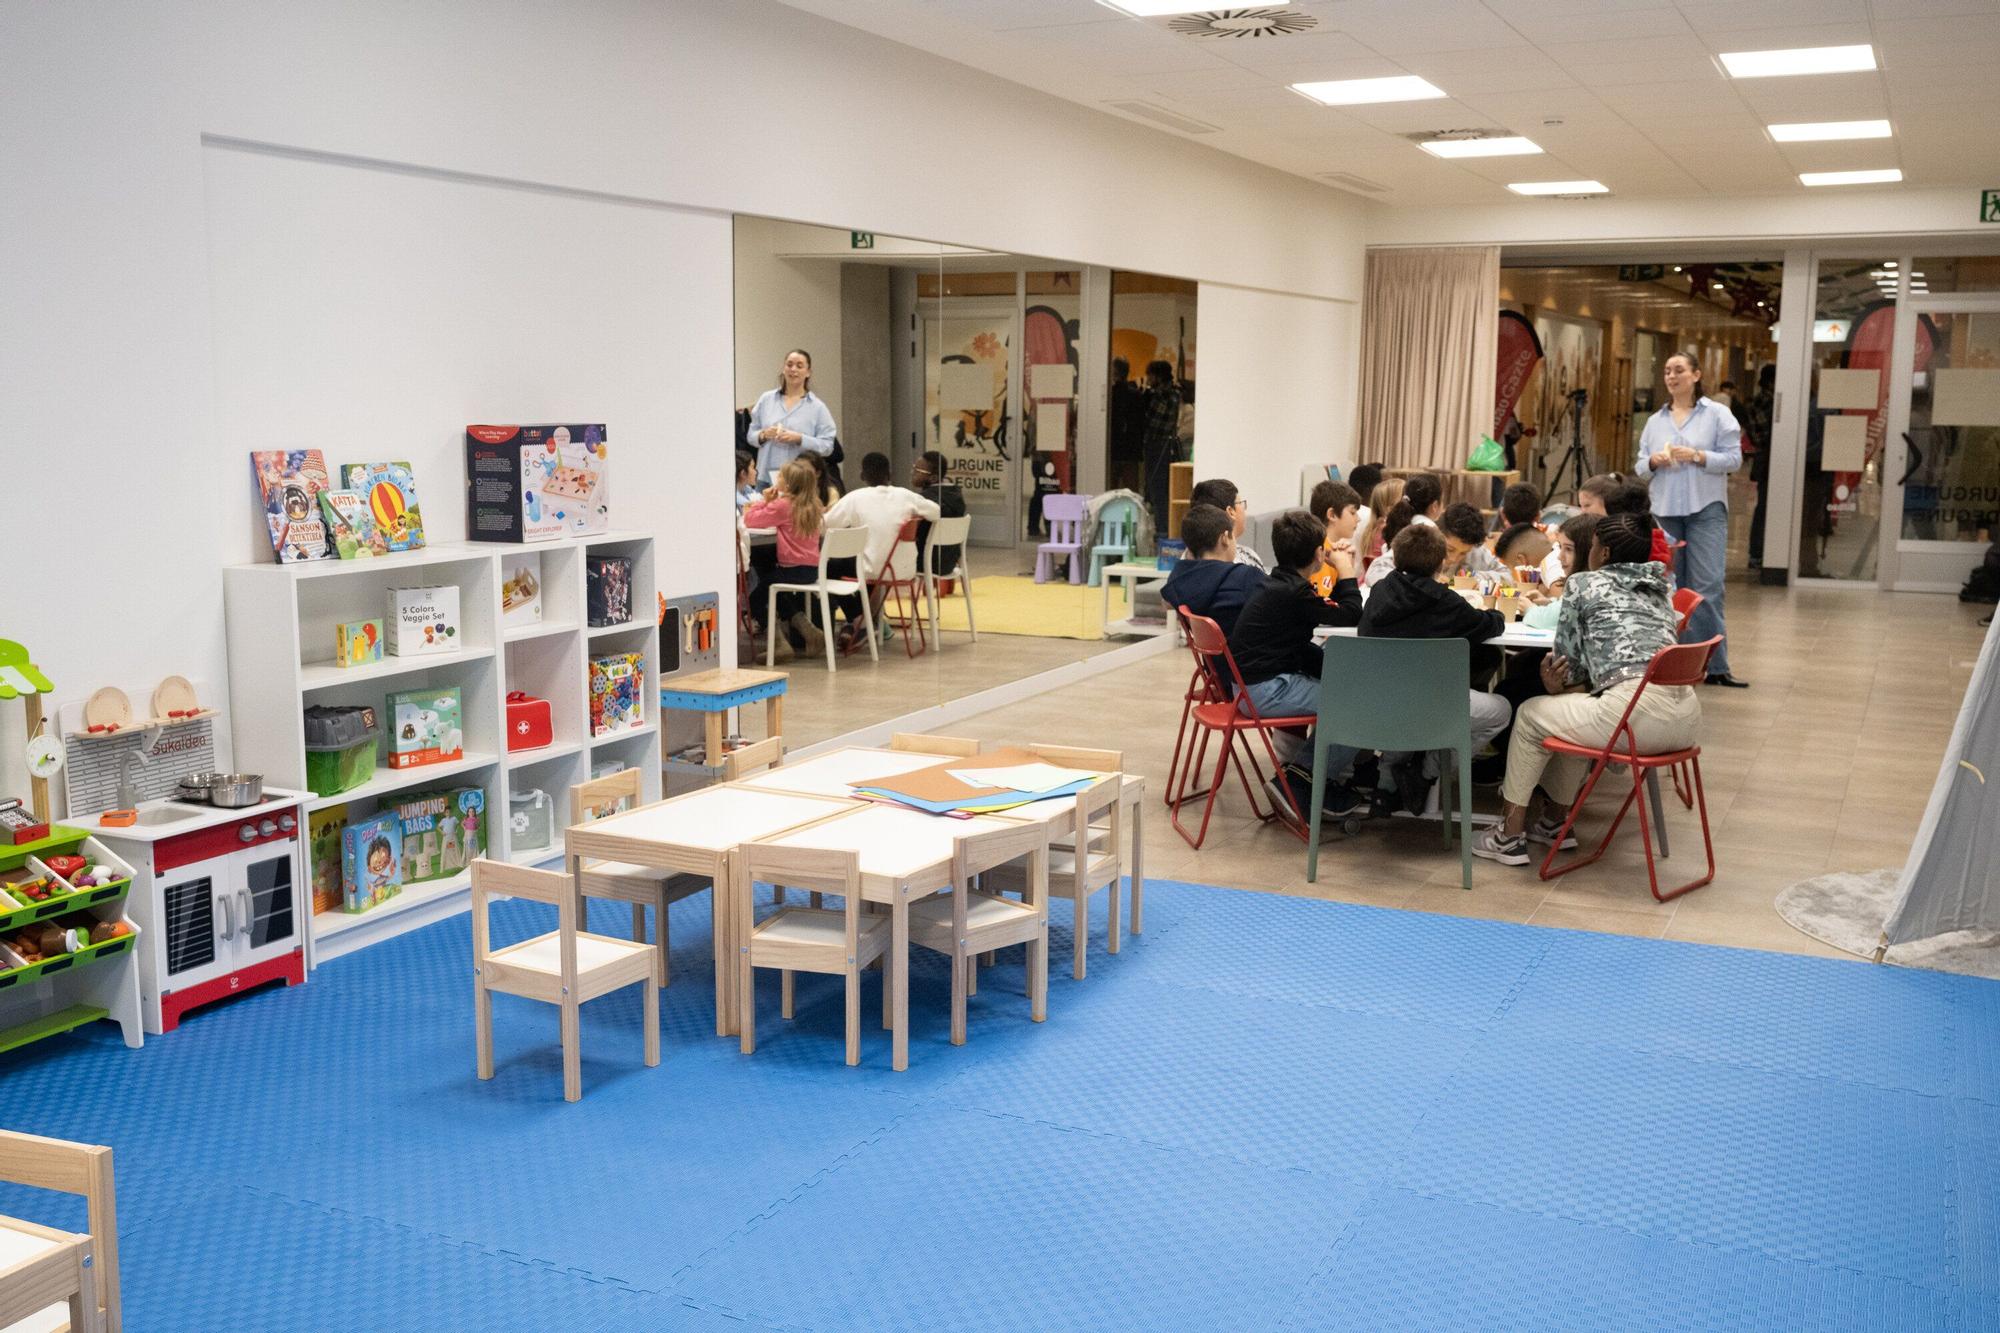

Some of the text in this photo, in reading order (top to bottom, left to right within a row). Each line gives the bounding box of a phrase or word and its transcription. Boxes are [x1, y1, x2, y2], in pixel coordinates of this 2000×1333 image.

[290, 522, 321, 533] SANSON
[402, 605, 435, 614] 5 Colors
[402, 614, 430, 623] Veggie
[152, 734, 206, 756] Sukaldea
[398, 798, 445, 820] JUMPING
[406, 815, 433, 834] BAGS
